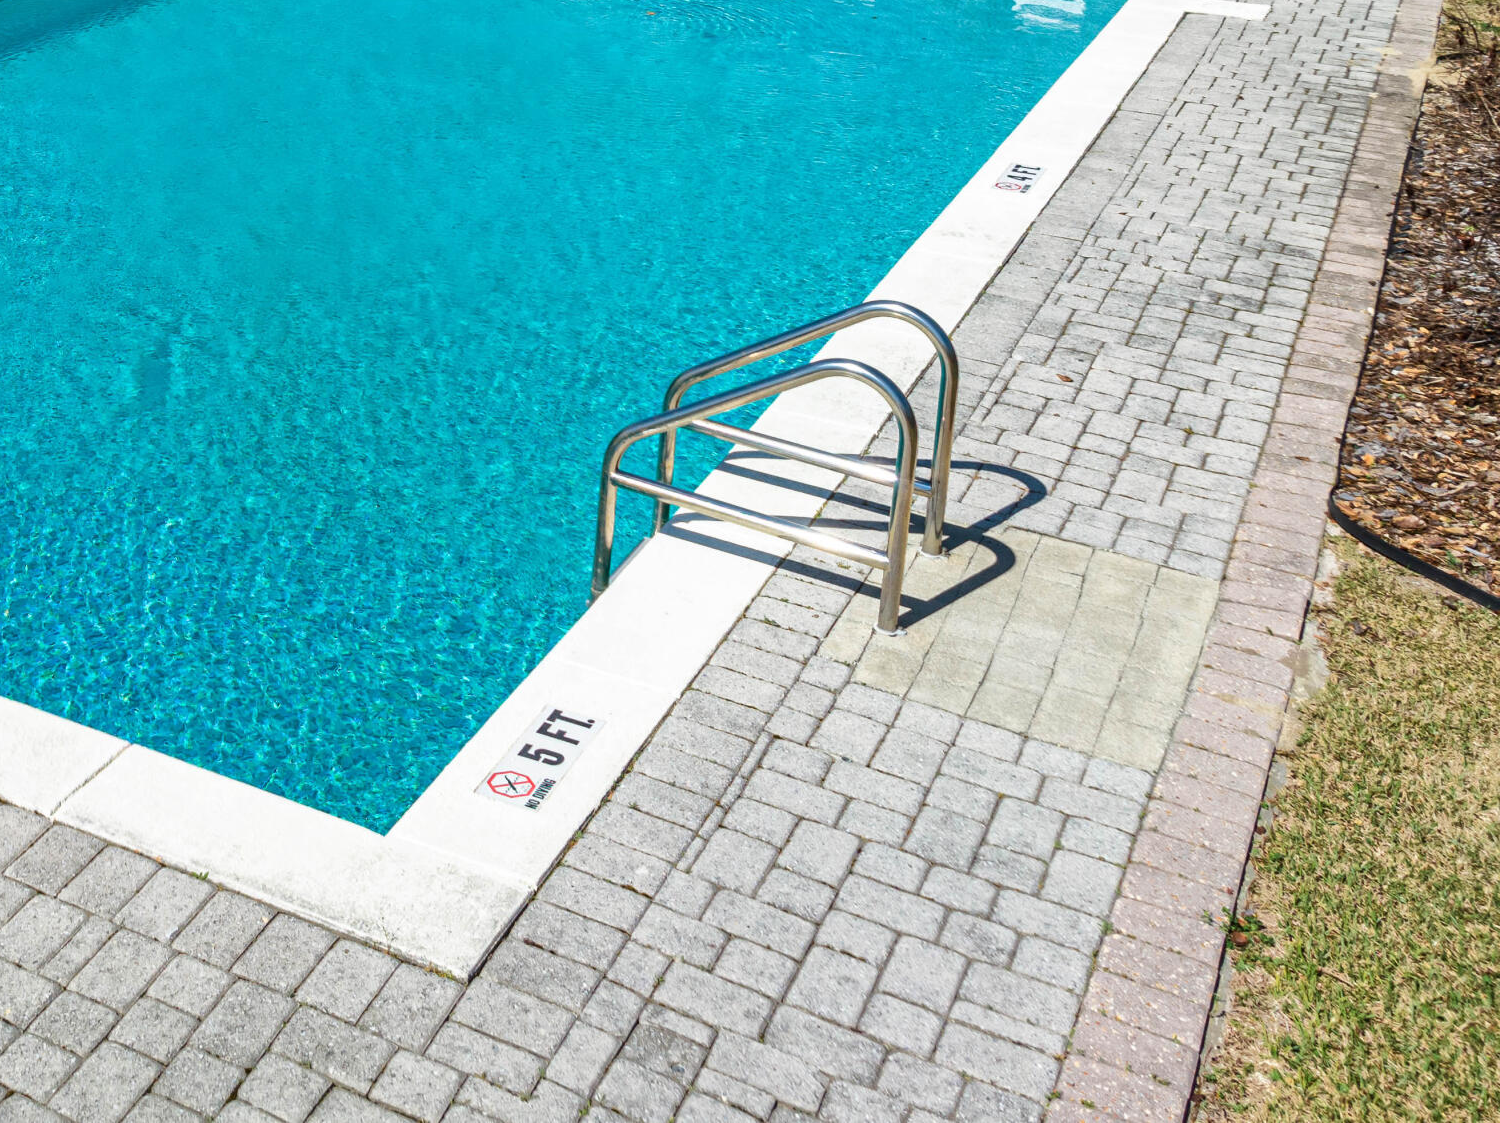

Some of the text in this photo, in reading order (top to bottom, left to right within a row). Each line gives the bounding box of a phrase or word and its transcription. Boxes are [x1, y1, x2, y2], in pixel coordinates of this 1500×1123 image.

[517, 708, 596, 766] 5 FT.
[524, 777, 557, 810] NO DIVING
